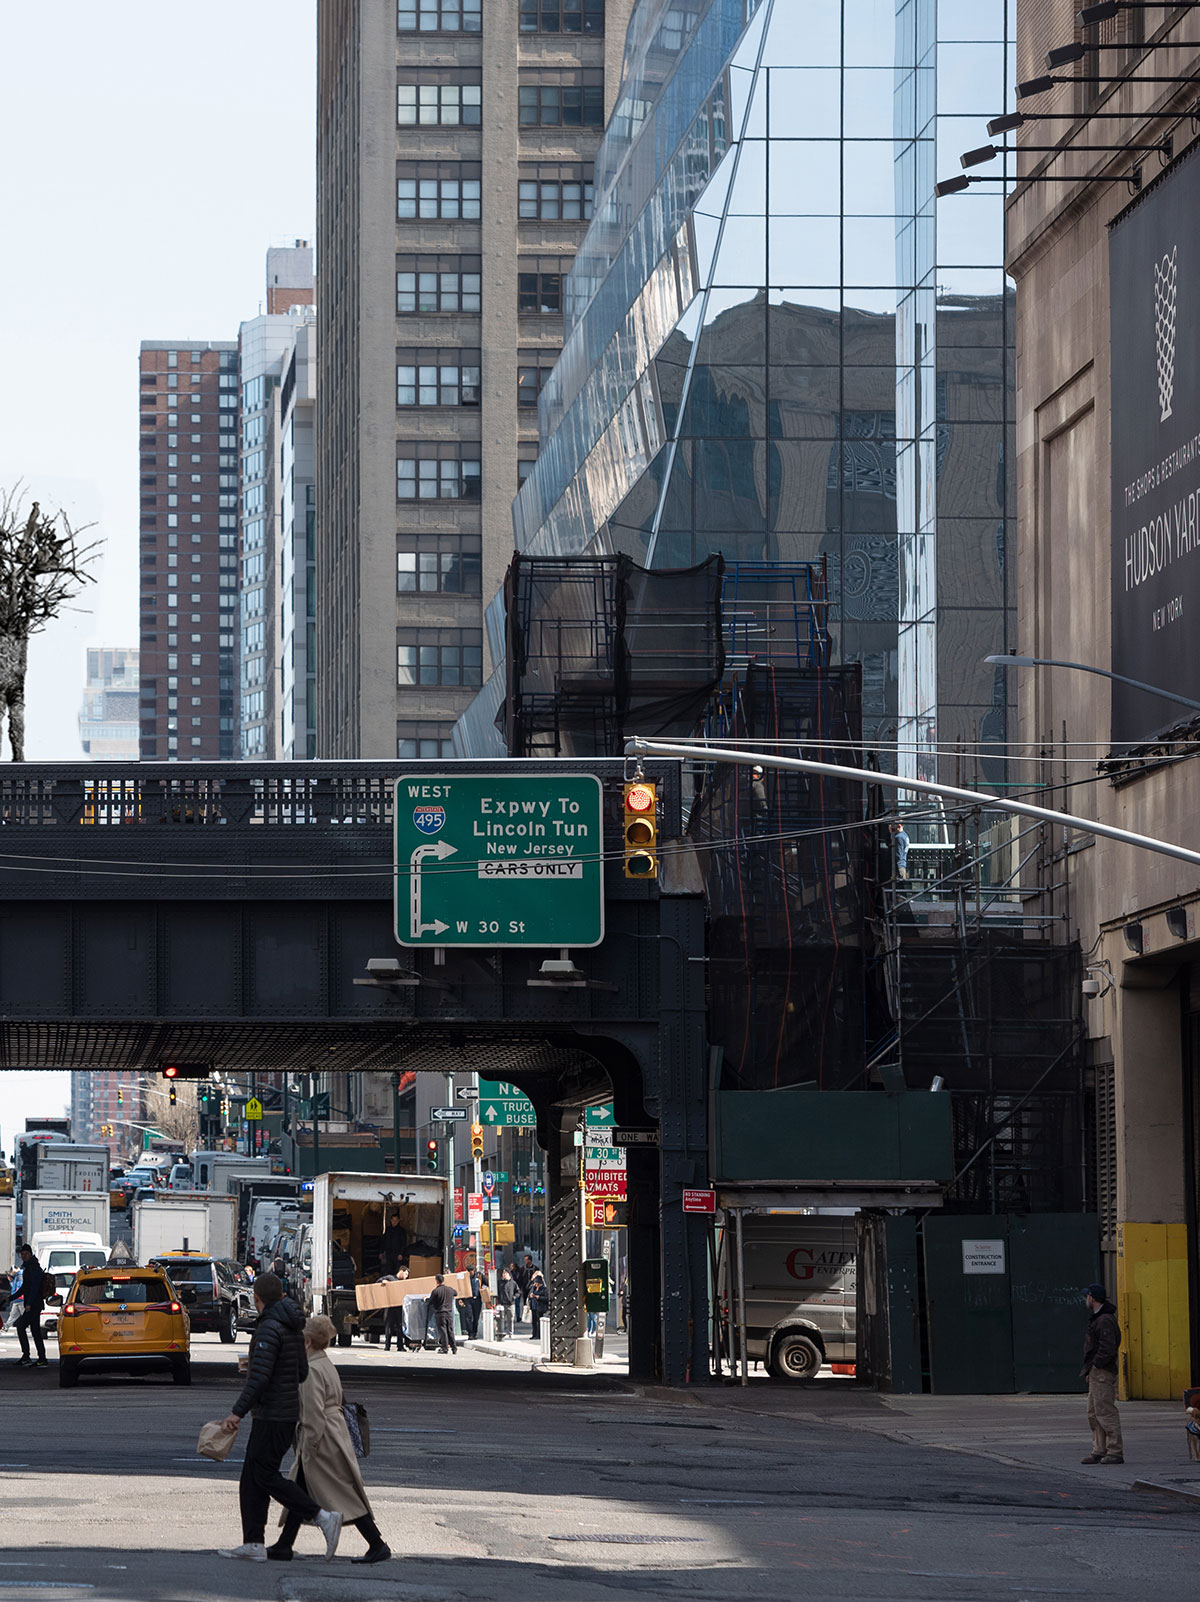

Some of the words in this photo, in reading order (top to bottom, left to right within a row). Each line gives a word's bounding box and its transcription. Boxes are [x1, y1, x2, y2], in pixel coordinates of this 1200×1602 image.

[1124, 482, 1136, 507] THE
[1137, 467, 1155, 500] SHOPS
[1156, 464, 1161, 487] &
[1125, 508, 1172, 592] HUDSON
[1152, 605, 1166, 632] NEW
[1167, 594, 1184, 624] YORK
[408, 786, 451, 798] WEST
[481, 798, 550, 817] Expwy
[558, 798, 580, 814] To
[416, 813, 442, 827] 495
[473, 820, 546, 837] Lincoln
[552, 820, 588, 837] Tun
[487, 843, 518, 855] New
[523, 843, 574, 857] Jersey
[484, 863, 528, 875] CARS
[534, 863, 576, 875] ONLY
[456, 921, 468, 933] W
[478, 921, 499, 933] 30
[509, 921, 525, 933] St
[499, 1082, 520, 1095] Ne
[621, 1133, 639, 1141] ONE
[647, 1133, 660, 1141] WA
[586, 1148, 594, 1159] W
[596, 1148, 609, 1159] 30
[786, 1247, 856, 1281] GATE
[816, 1266, 856, 1275] ENTERPR
